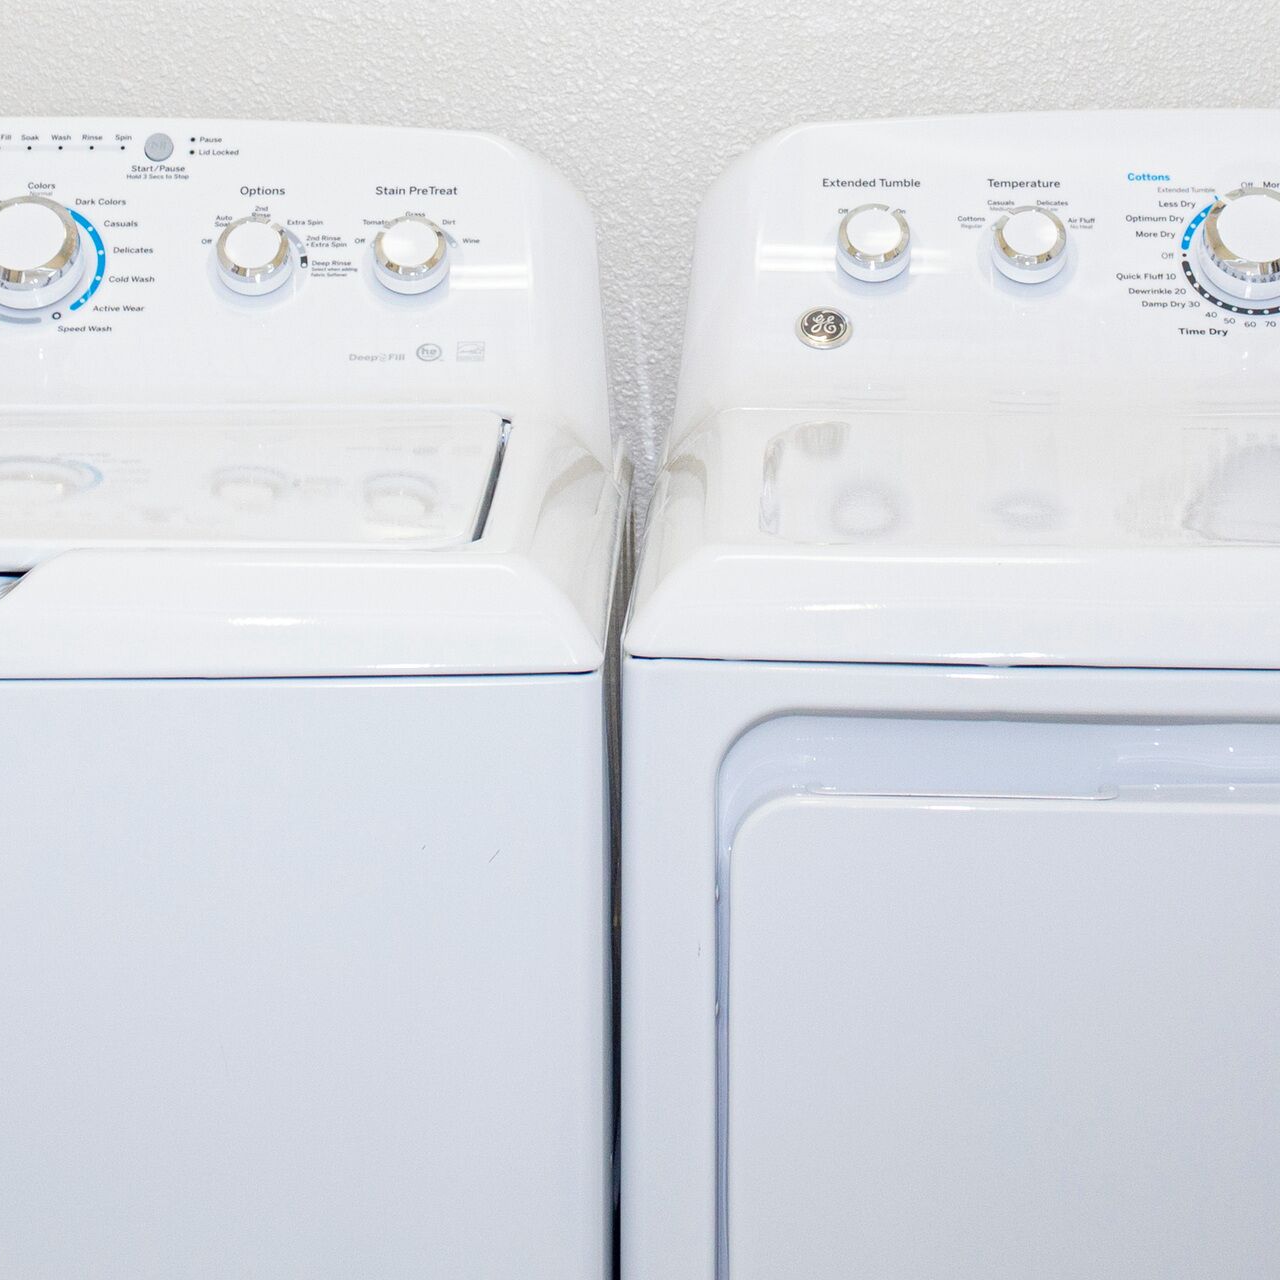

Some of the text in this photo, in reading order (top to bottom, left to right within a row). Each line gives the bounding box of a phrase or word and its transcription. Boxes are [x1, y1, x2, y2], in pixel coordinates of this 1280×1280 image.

[1128, 173, 1170, 181] Cottons
[823, 179, 921, 187] Extended Tumble
[987, 179, 1060, 189] Temperature
[240, 186, 285, 196] Options
[375, 186, 458, 196] Stain PreTreat
[1180, 201, 1196, 209] Dry
[1169, 215, 1184, 223] Dry
[1209, 328, 1228, 336] Dry
